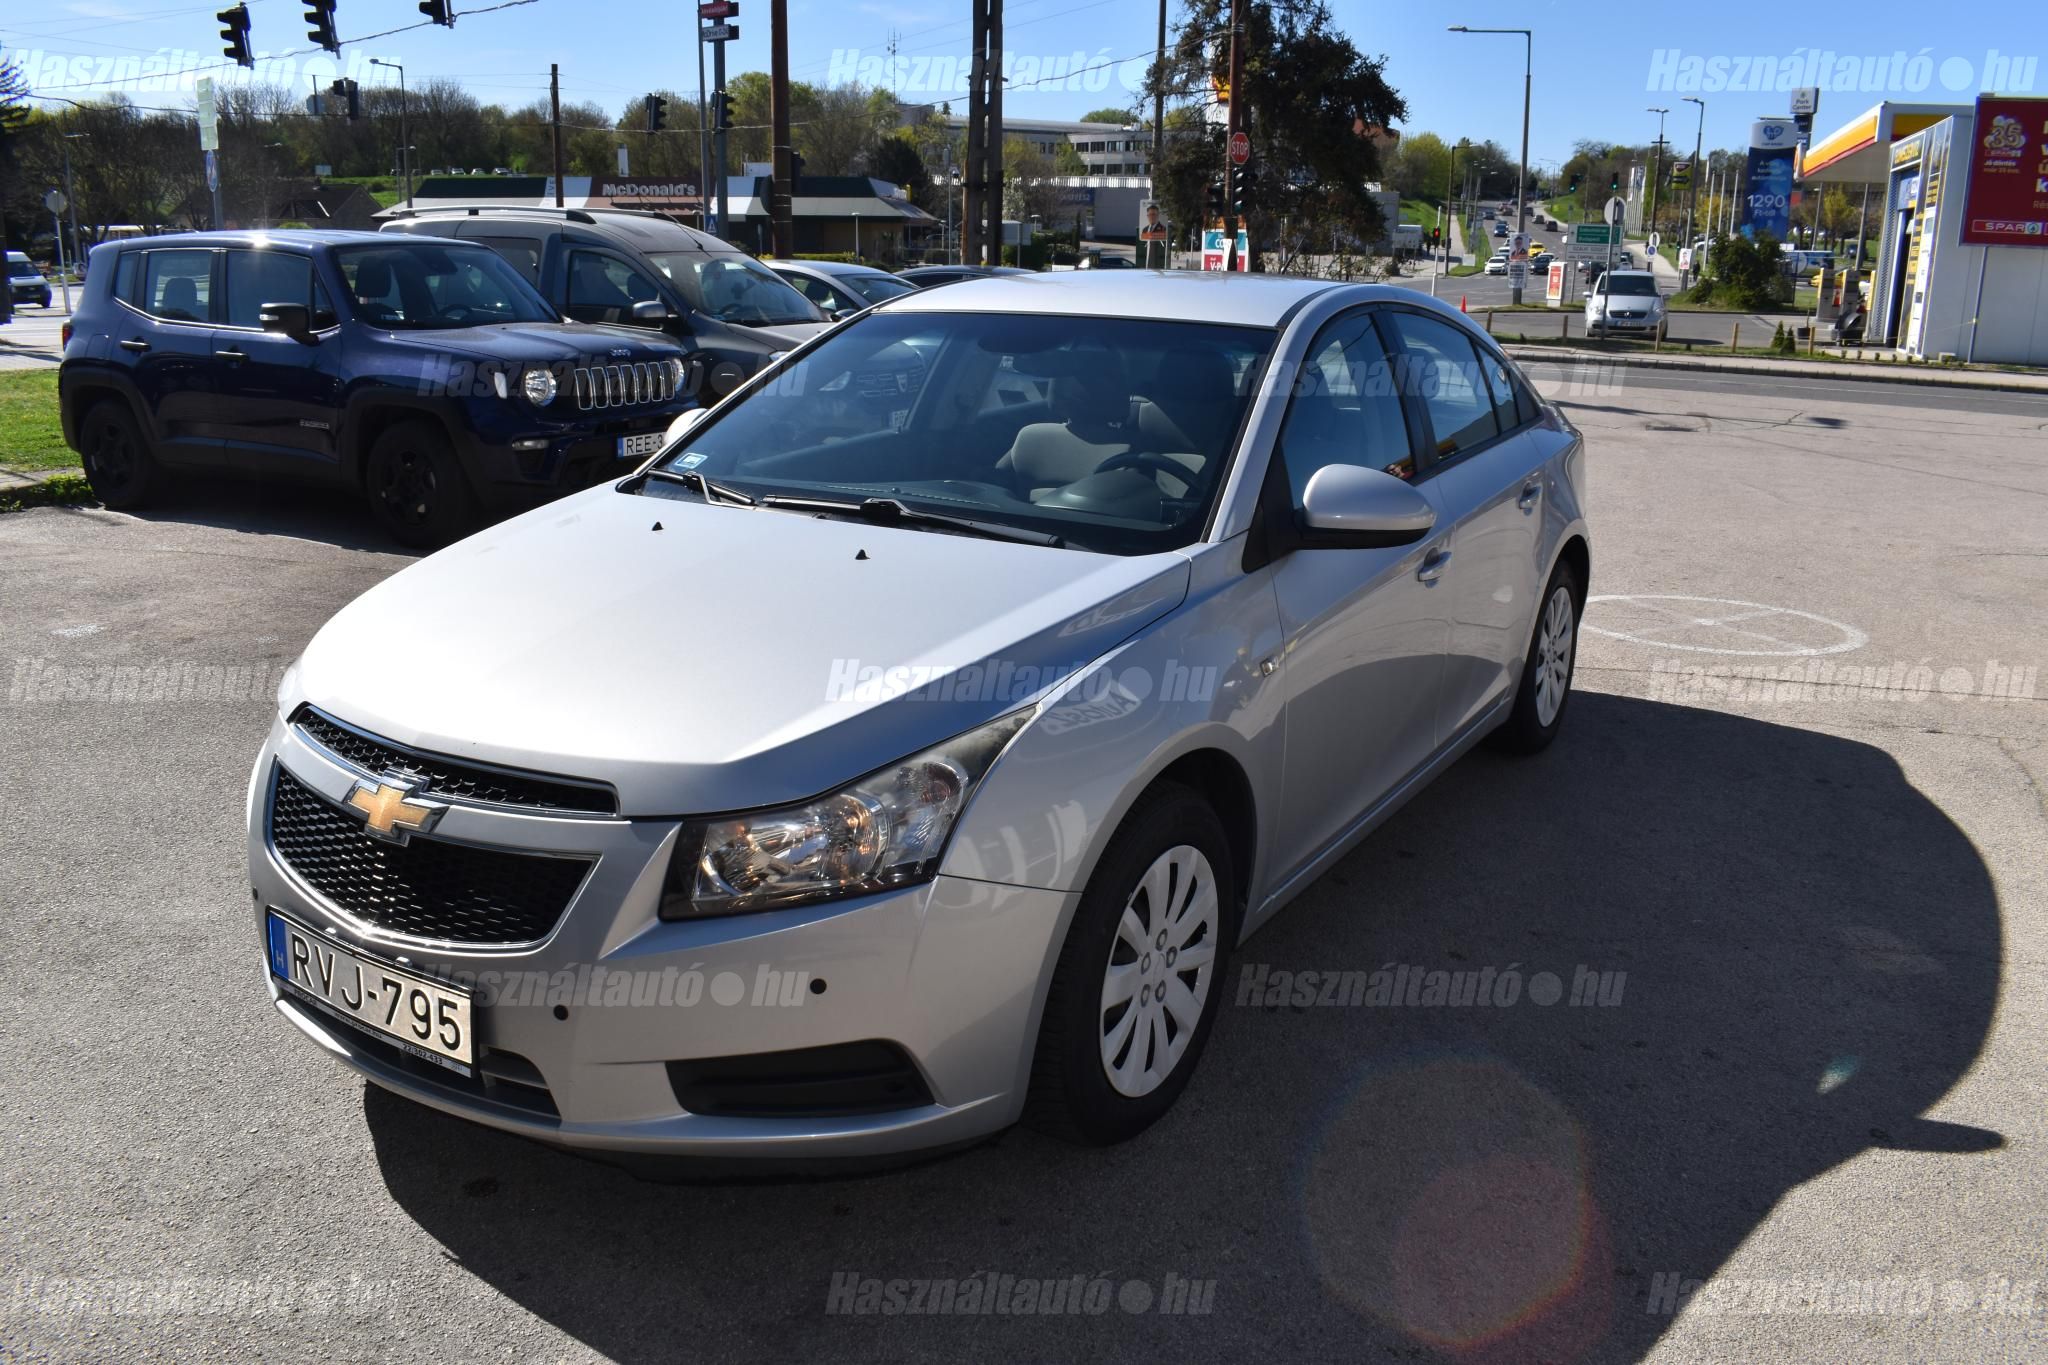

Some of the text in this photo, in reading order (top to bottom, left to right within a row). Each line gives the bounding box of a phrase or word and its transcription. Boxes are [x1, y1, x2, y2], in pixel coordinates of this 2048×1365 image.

[1232, 141, 1248, 155] STOP
[602, 183, 697, 197] McDonald's
[1747, 194, 1786, 208] 1290
[1985, 222, 2026, 232] SPAR
[626, 434, 664, 455] REE-3
[291, 931, 464, 1051] RVJ-795
